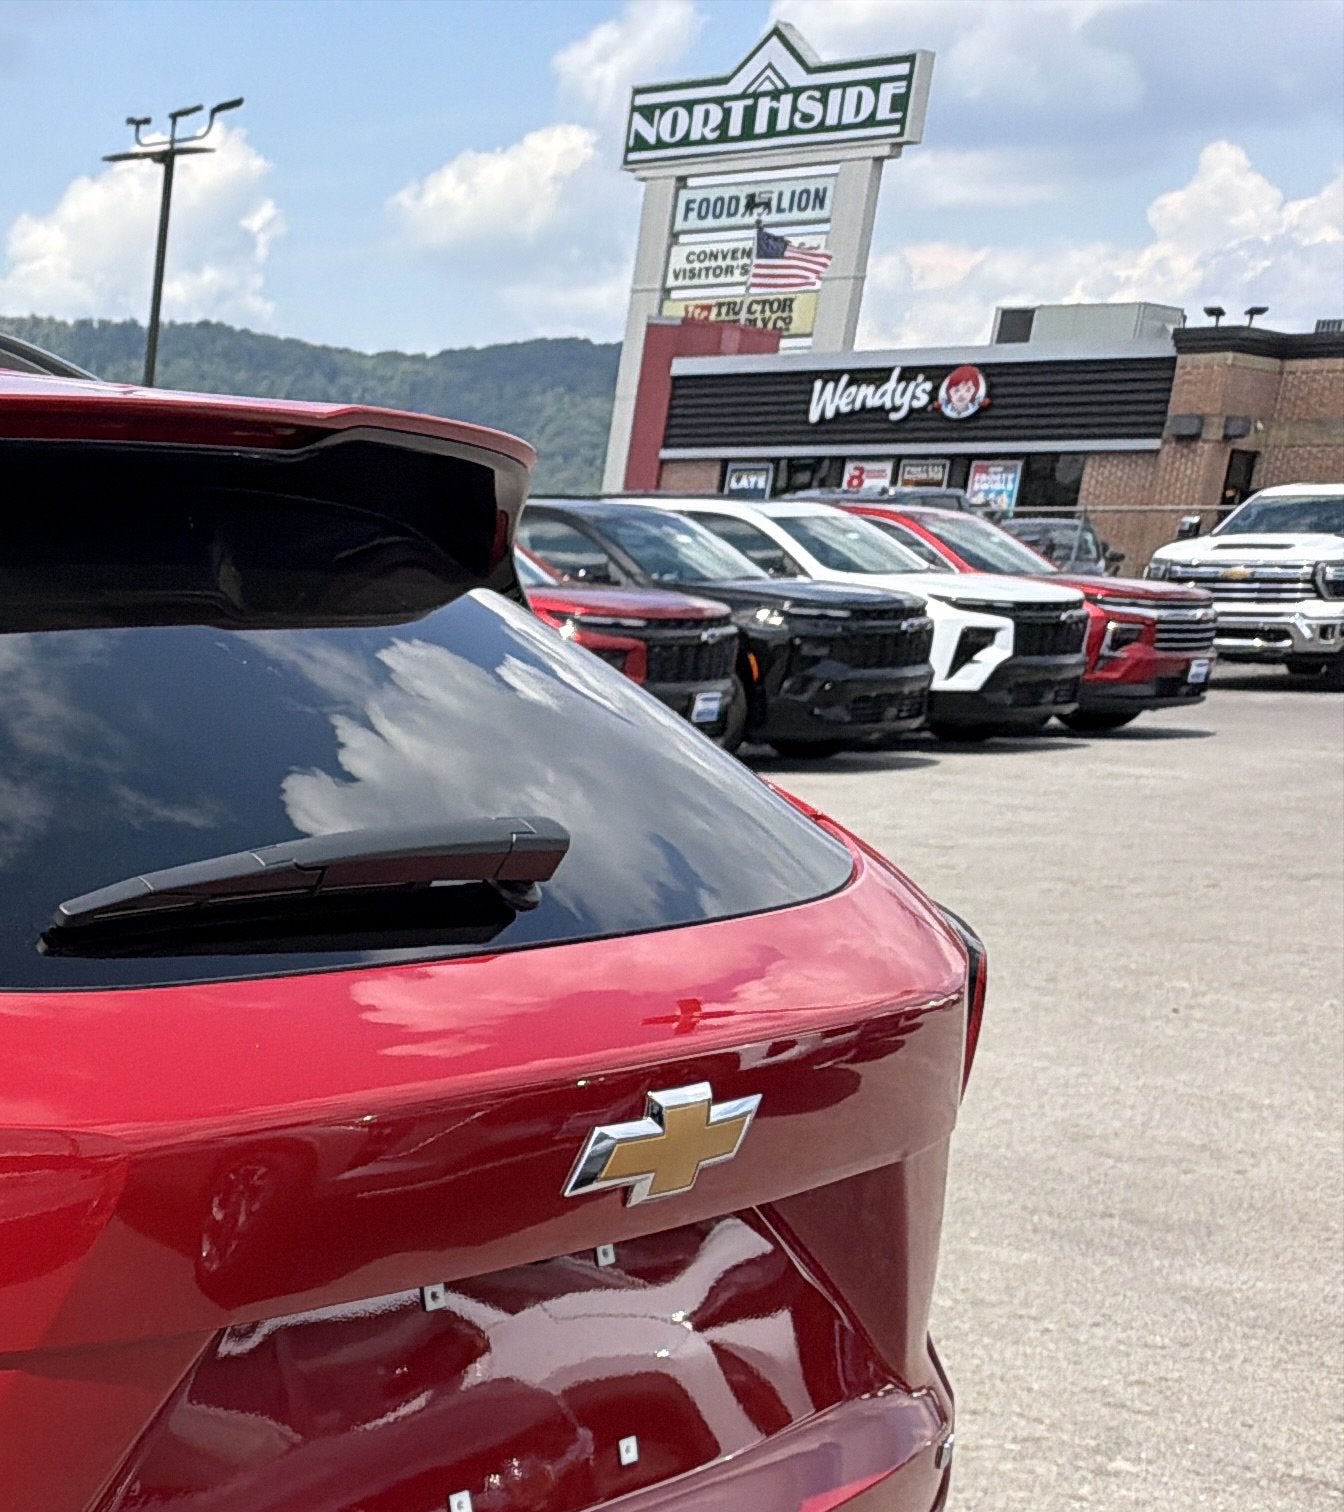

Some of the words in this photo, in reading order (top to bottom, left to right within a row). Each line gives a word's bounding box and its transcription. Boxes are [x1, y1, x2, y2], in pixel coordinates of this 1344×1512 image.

[628, 81, 907, 147] NORTHSIDE
[683, 195, 740, 221] FOOD
[776, 187, 827, 213] LION
[672, 263, 750, 281] VISITOR'S
[685, 247, 752, 264] CONVEN
[809, 366, 933, 423] Wendy's
